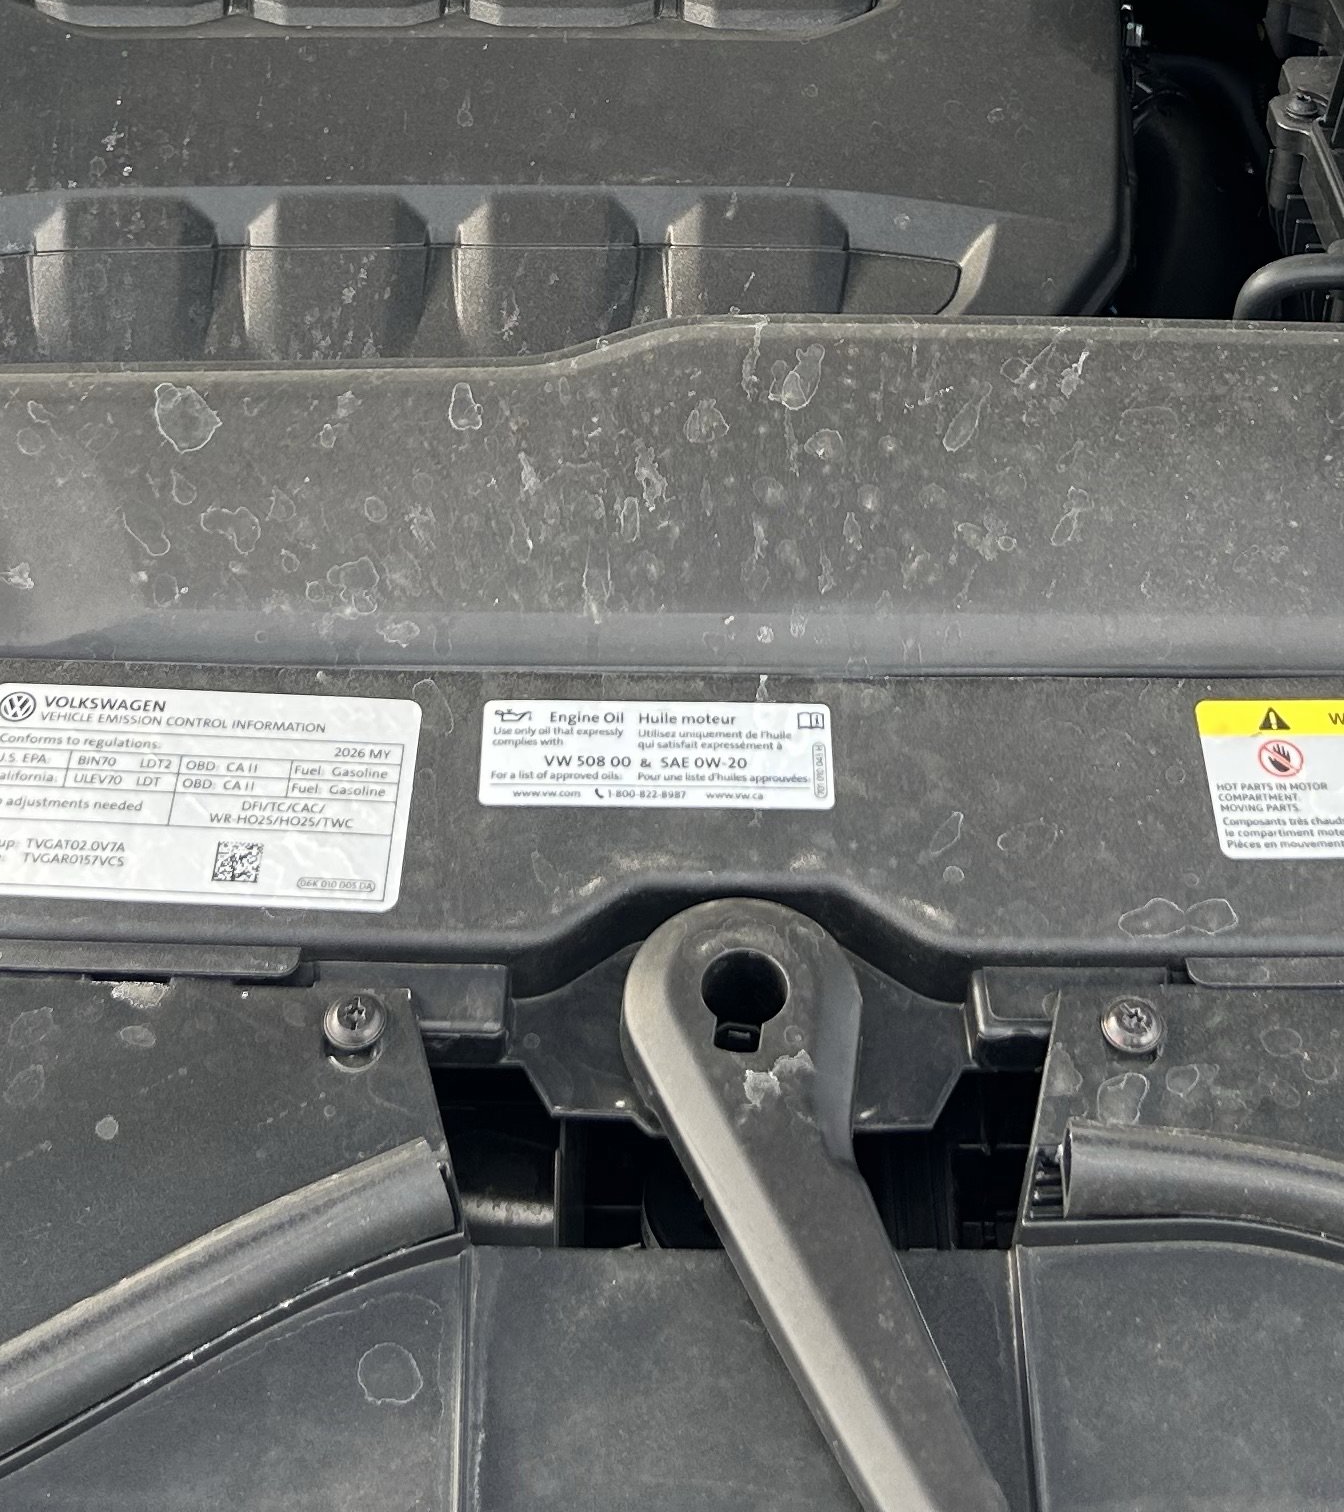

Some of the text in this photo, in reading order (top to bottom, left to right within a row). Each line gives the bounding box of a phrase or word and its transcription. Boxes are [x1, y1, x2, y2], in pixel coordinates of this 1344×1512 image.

[45, 695, 166, 712] VOLKSWAGEN
[41, 711, 326, 733] VEHICLE EMISSION CONTROL INFORMATION
[550, 711, 624, 726] Engine Oil
[639, 713, 736, 726] Huile moteur
[0, 732, 63, 745] Conforms
[66, 736, 80, 745] to
[493, 727, 624, 739] Use only oil that expressly
[638, 730, 676, 739] Utilisez
[678, 730, 743, 740] uniquement
[745, 731, 758, 739] de
[492, 738, 537, 748] complies
[638, 740, 783, 751] qui satisfait expressément à
[334, 747, 391, 759] 2026 MY
[77, 755, 172, 769] BIN70 LDT2
[227, 762, 244, 773] CA
[544, 755, 748, 769] VW 508 00 & SAE 0W-20
[332, 766, 388, 779] Gasoline
[491, 770, 507, 779] For
[518, 770, 534, 779] list
[536, 770, 548, 779] of
[550, 771, 599, 782] approved
[638, 772, 661, 781] Pour
[685, 772, 705, 781] liste
[73, 773, 161, 787] ULEV70 LDT
[223, 779, 241, 791] CA
[328, 784, 386, 797] Gasoline
[1216, 782, 1328, 791] HOT PARTS IN MOTOR
[512, 789, 582, 798] www.vw.com
[705, 791, 764, 801] www.vw.ca
[6, 797, 90, 810] adjustments
[93, 800, 144, 811] needed
[241, 801, 326, 814] DFI/TC/CAC/
[1220, 804, 1264, 812] MOVING
[1222, 817, 1287, 827] Composants
[1225, 828, 1314, 839] le compartiment
[1227, 839, 1262, 849] Pièces
